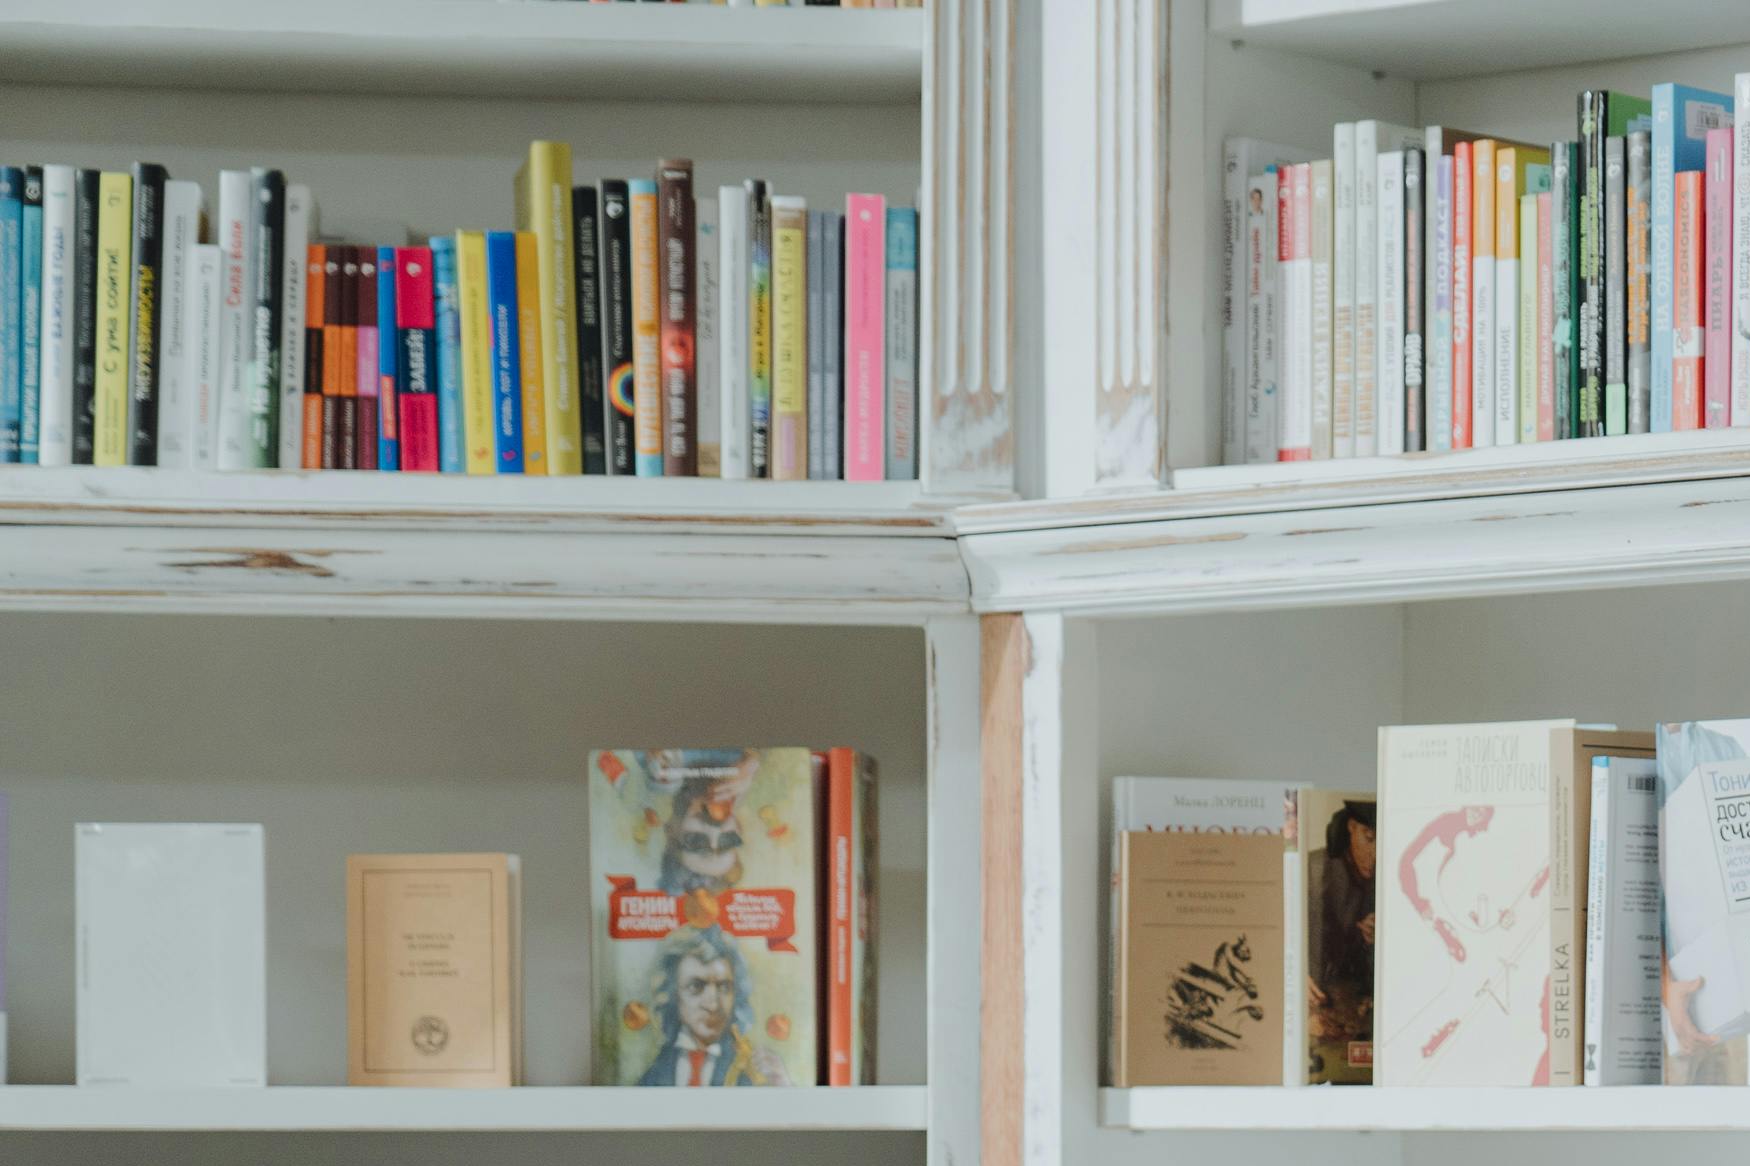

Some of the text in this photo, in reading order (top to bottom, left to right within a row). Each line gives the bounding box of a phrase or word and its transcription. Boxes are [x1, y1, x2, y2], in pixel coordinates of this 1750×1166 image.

[1435, 196, 1448, 294] ПОДКАСТ
[1652, 146, 1672, 331] НА ОДНОЙ ВОЛНЕ
[1314, 262, 1329, 423] РЕЖИМ ГЕНИЯ
[1711, 258, 1723, 332] ПИАРЬ
[1405, 334, 1421, 385] ДРАЙВ
[1499, 326, 1511, 421] ИСПОЛНЕНИЕ
[1456, 735, 1520, 762] ЗАПИСКИ
[1730, 879, 1747, 893] из
[1553, 943, 1571, 1039] STRELKA
